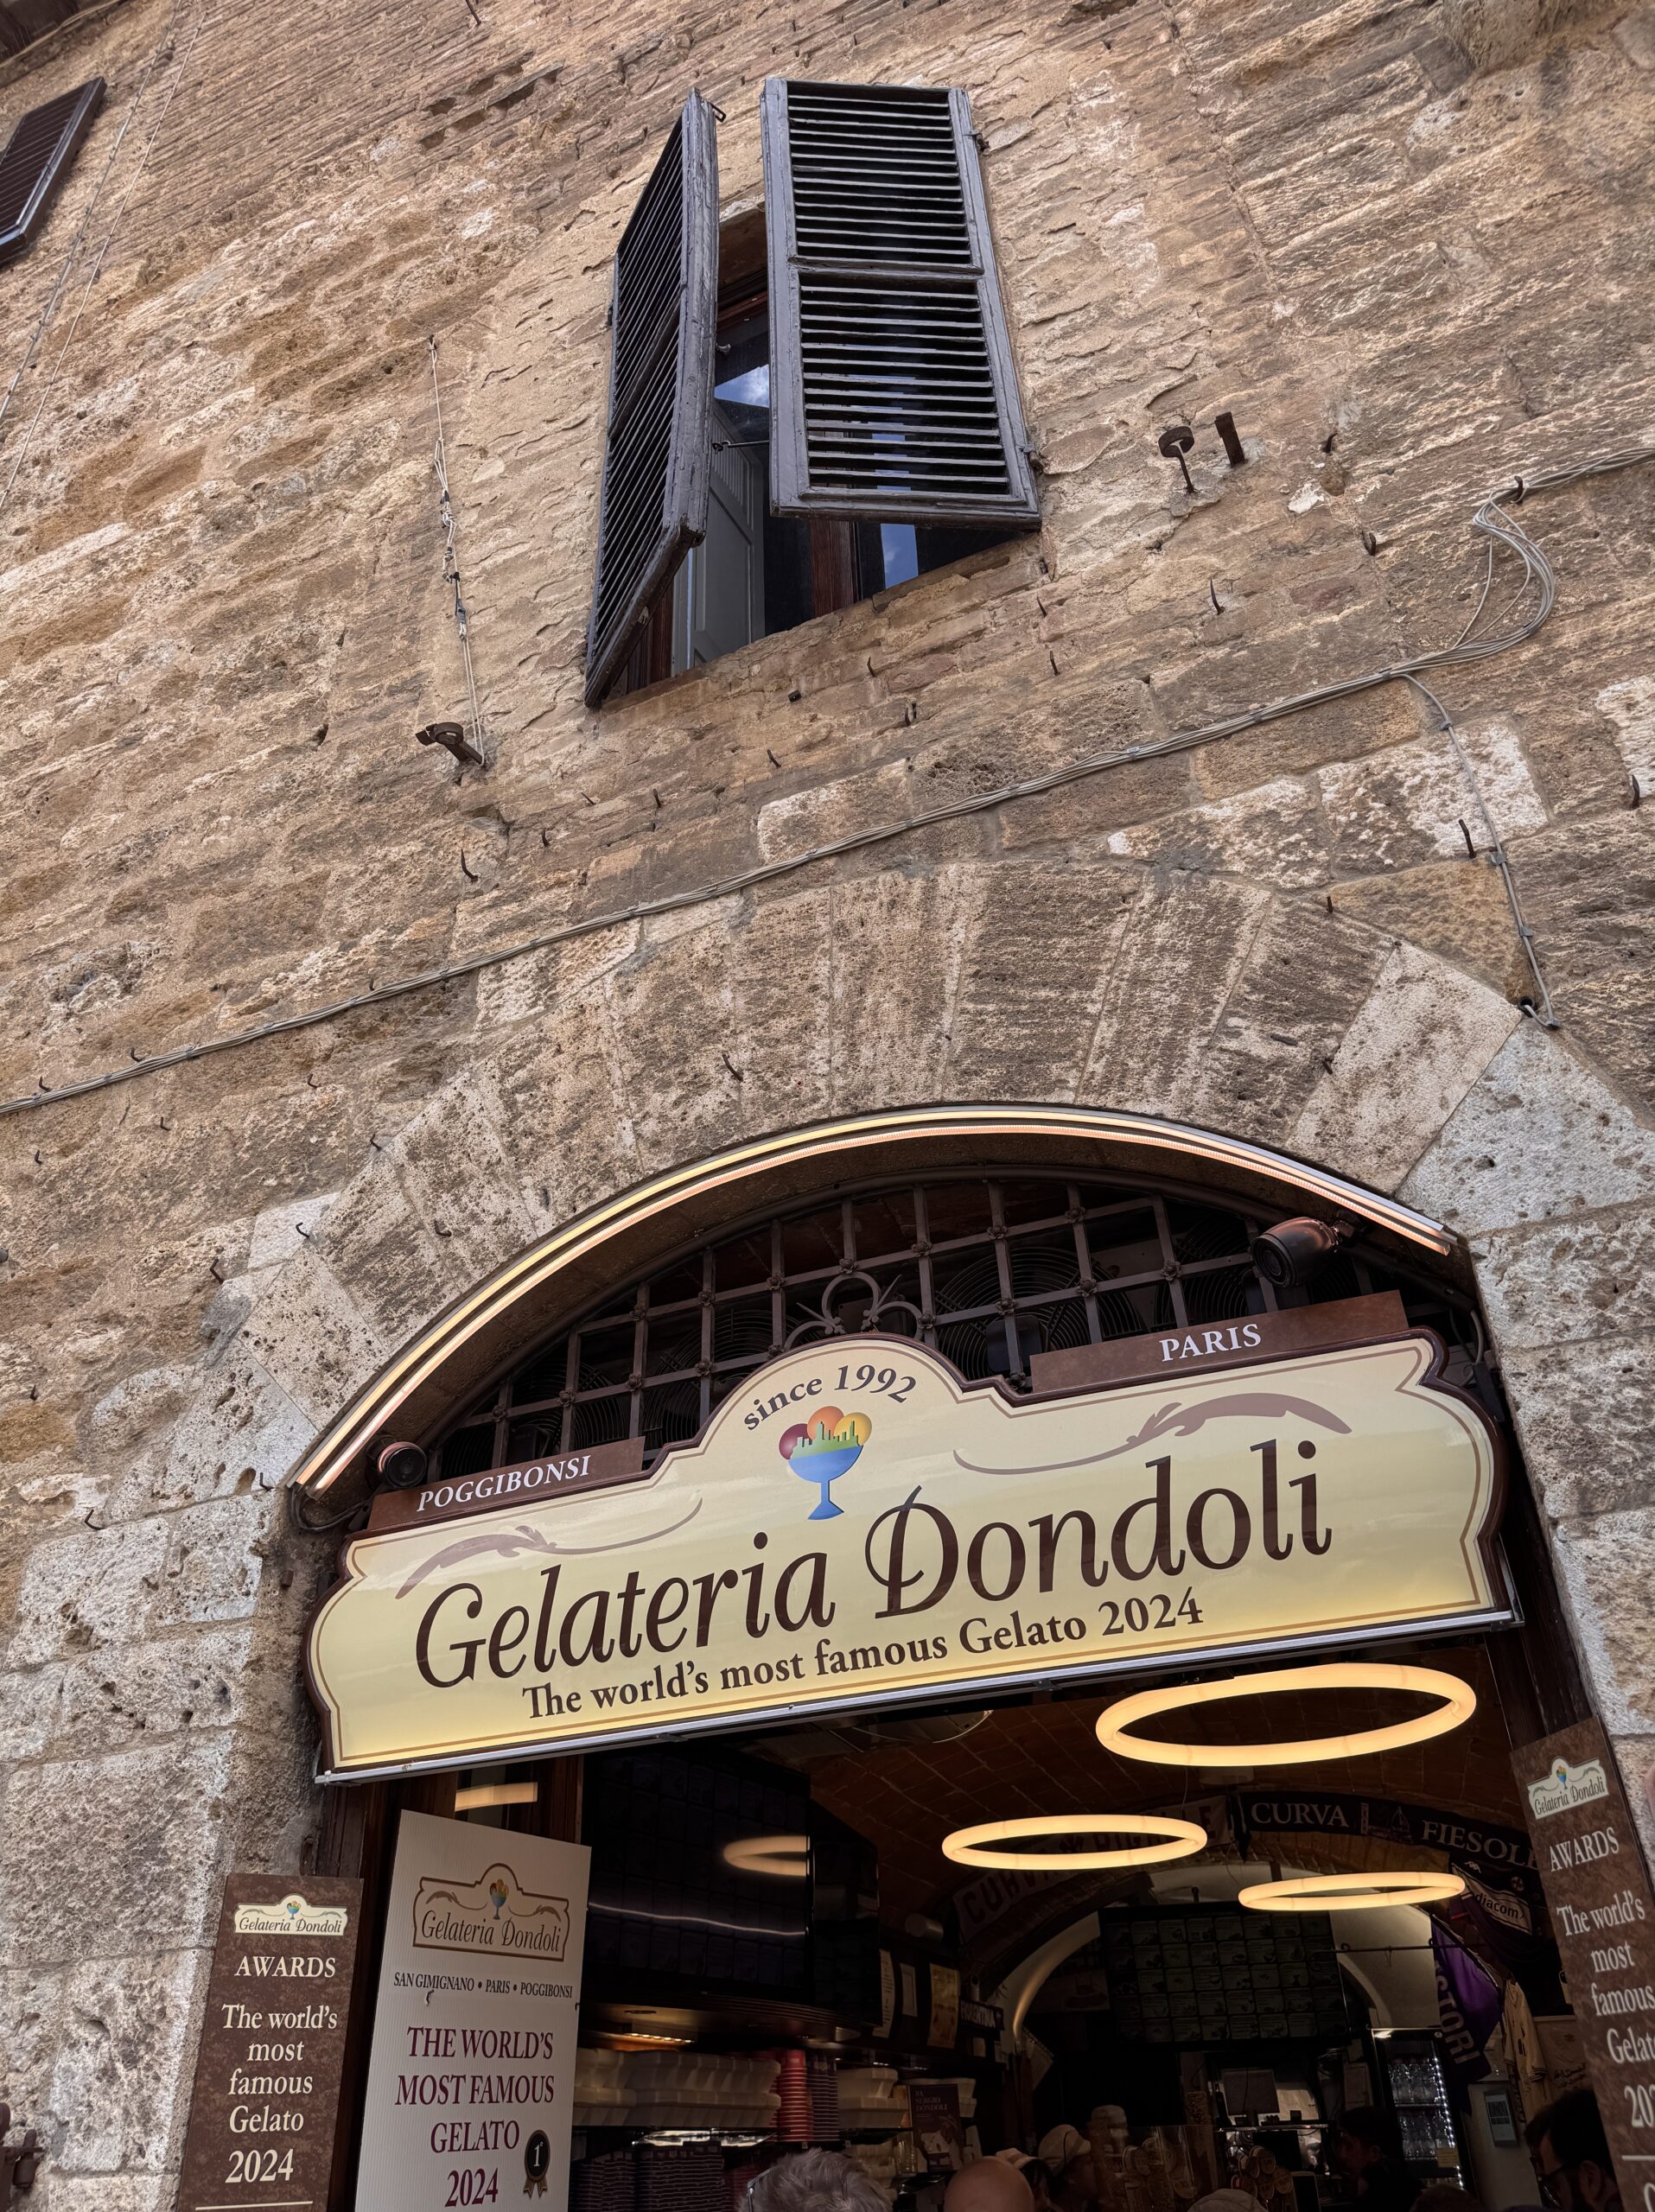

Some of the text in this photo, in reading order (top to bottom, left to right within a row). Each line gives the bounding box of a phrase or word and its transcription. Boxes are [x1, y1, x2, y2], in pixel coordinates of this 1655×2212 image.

[1159, 1324, 1263, 1363] PARIS
[744, 1363, 917, 1432] since 1992
[416, 1454, 591, 1512] POGGIBONSI
[416, 1439, 1333, 1689] Gelateria Dondoli
[522, 1586, 1205, 1719] The world's most famous Gelato 2024
[1534, 1777, 1606, 1815] Gelateria Dondoli
[1251, 1802, 1350, 1828] CURVA
[1549, 1826, 1620, 1872] AWARDS
[239, 1917, 342, 1933] Gelateria Dondoli
[1556, 1889, 1645, 1936] The world's
[421, 1910, 562, 1952] Gelateria Dondoli
[234, 1955, 336, 1978] AWARDS
[1590, 1940, 1635, 1974] most
[393, 1972, 573, 1998] SAN GIMIGNANO PARIS POGGIBONSI
[1591, 1981, 1655, 2017] famous
[220, 2004, 338, 2030] The world's
[246, 2041, 304, 2062] most
[406, 2025, 553, 2059] THE WORLD'S
[1607, 2026, 1655, 2064] Gelat
[228, 2068, 313, 2095] famous
[395, 2074, 554, 2106] MOST FAMOUS
[229, 2105, 304, 2133] Gelato
[430, 2120, 520, 2153] GELATO
[225, 2148, 295, 2183] 2024
[444, 2167, 499, 2208] 2024
